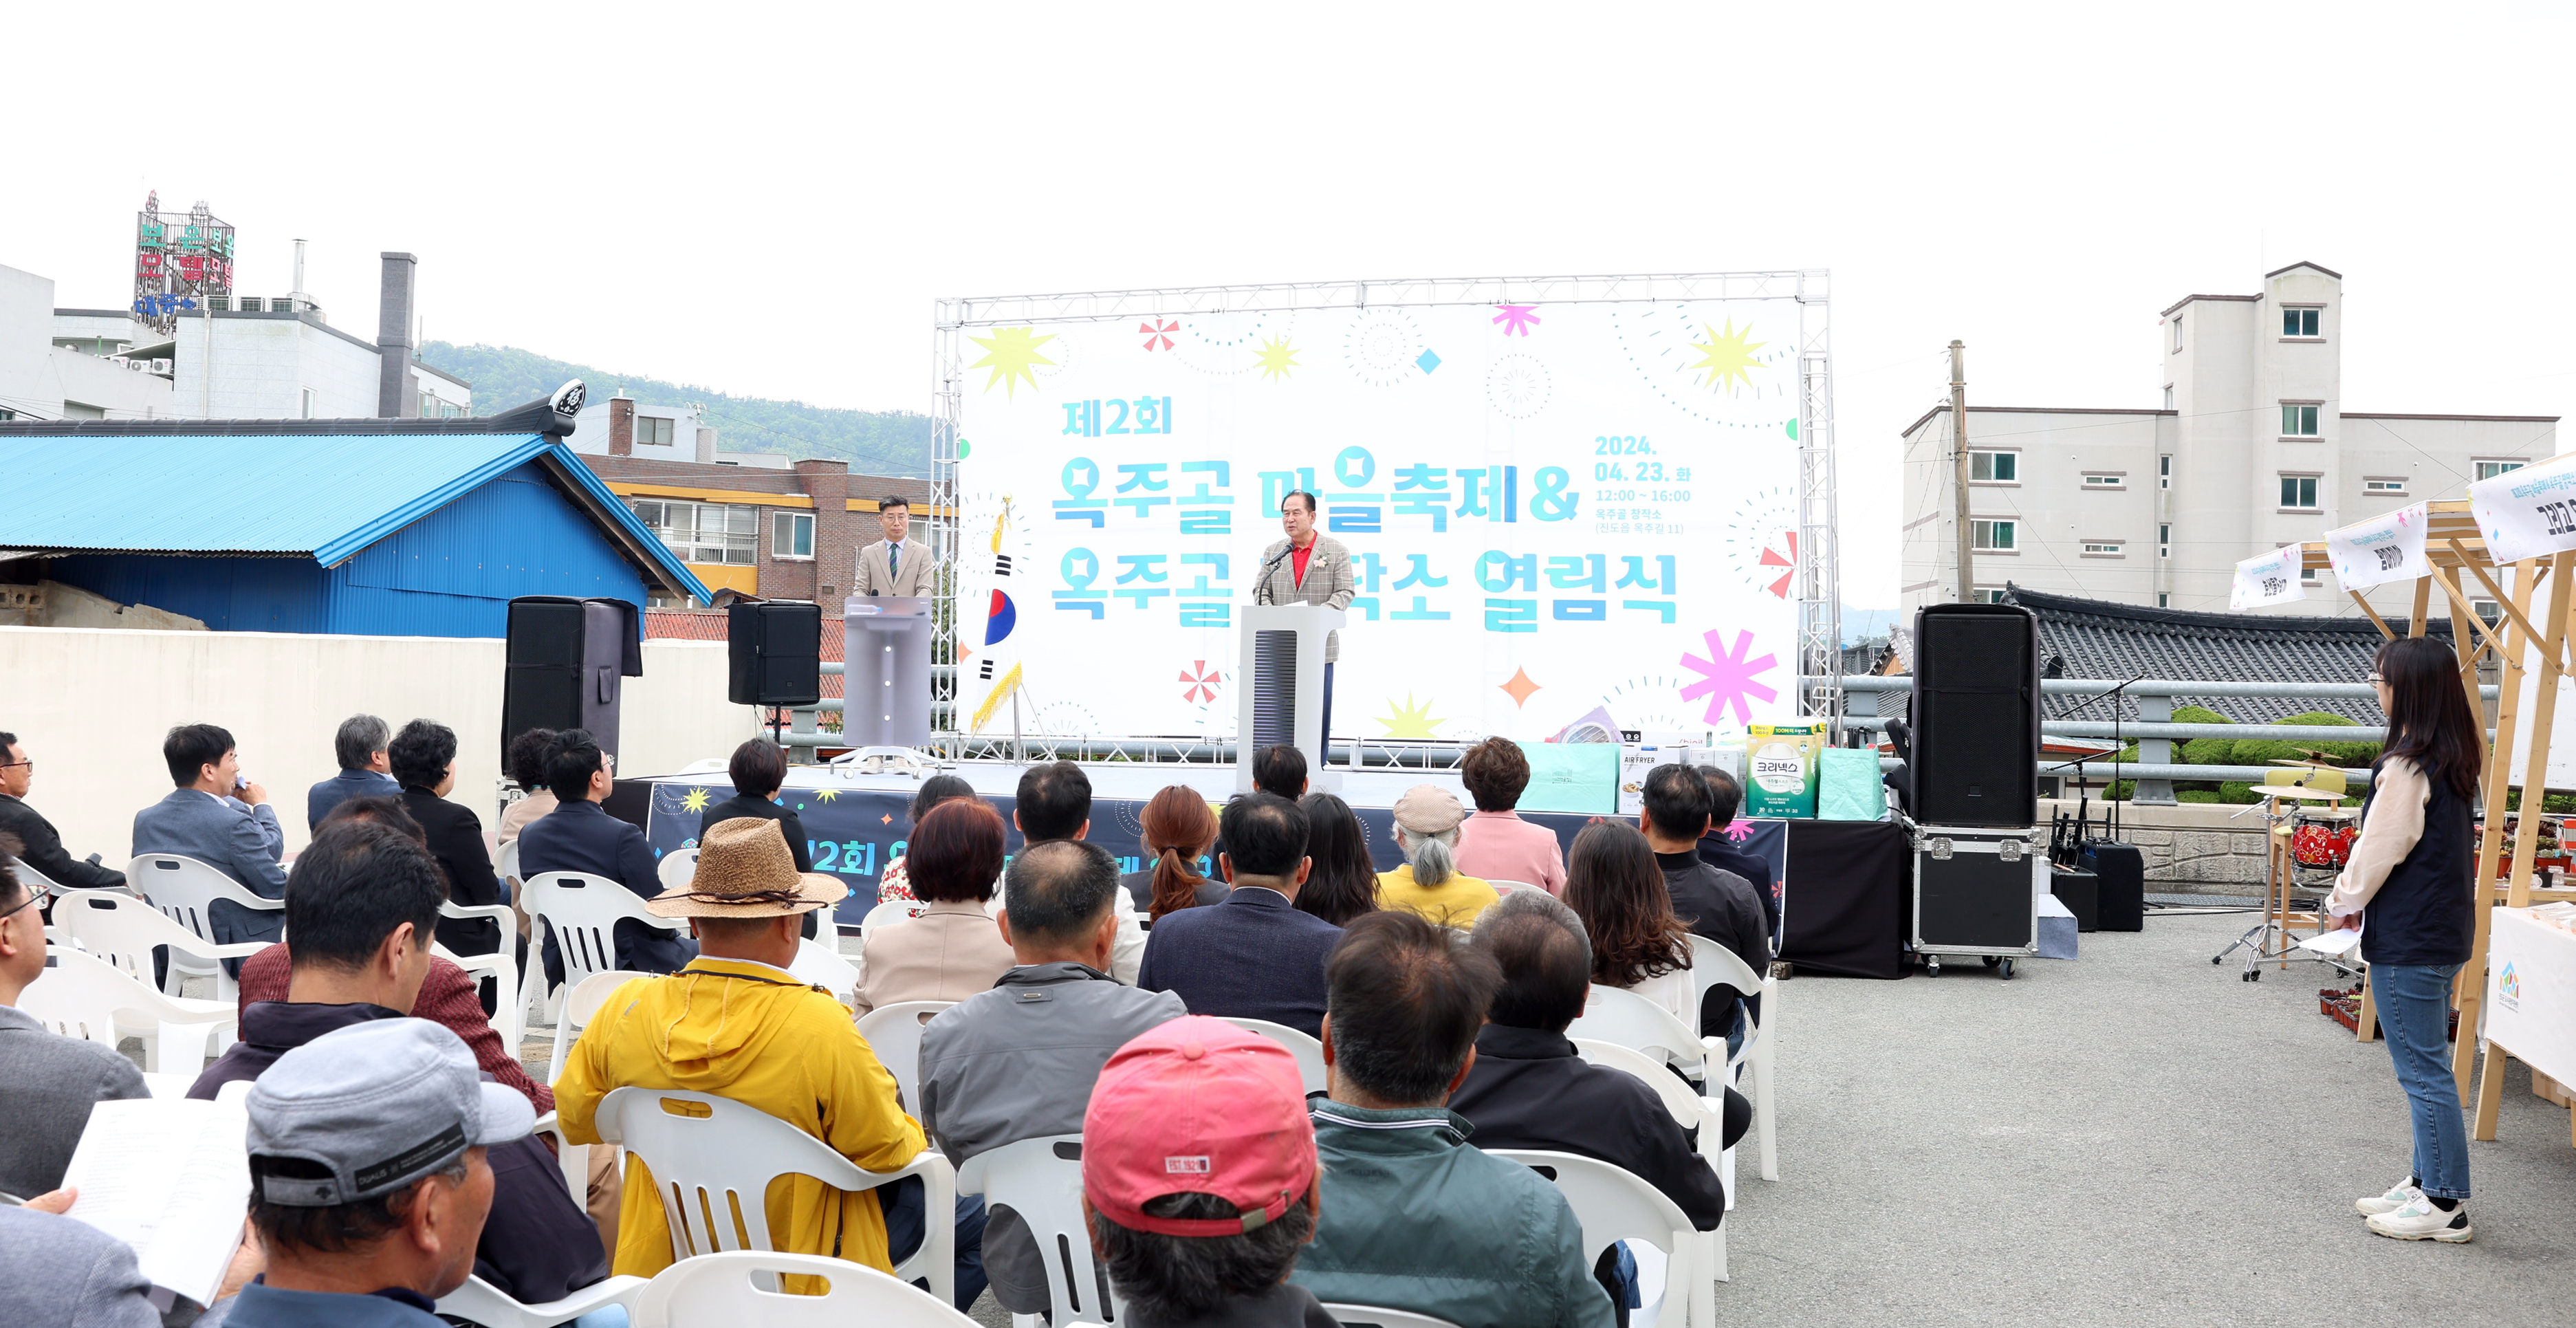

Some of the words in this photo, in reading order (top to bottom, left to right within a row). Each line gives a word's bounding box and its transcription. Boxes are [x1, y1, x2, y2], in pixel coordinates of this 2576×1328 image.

[138, 254, 204, 281] 모텔
[1062, 395, 1171, 437] 제2회
[1595, 436, 1657, 455] 2024.
[1595, 462, 1628, 481] 04.
[1636, 461, 1670, 481] 23.
[1676, 467, 1691, 482] 화
[1052, 457, 1234, 534] 옥주골
[1596, 490, 1635, 501] 12:00
[1651, 490, 1690, 501] 16:00
[1595, 508, 1627, 520] 옥주골
[1630, 508, 1662, 520] 창작소
[1595, 523, 1630, 534] (진도읍
[1634, 523, 1664, 534] 옥주길
[1051, 547, 1234, 628] 옥주골
[1474, 550, 1677, 633] 열림식
[1757, 762, 1799, 773] 크리넥스
[807, 840, 875, 876] 2회
